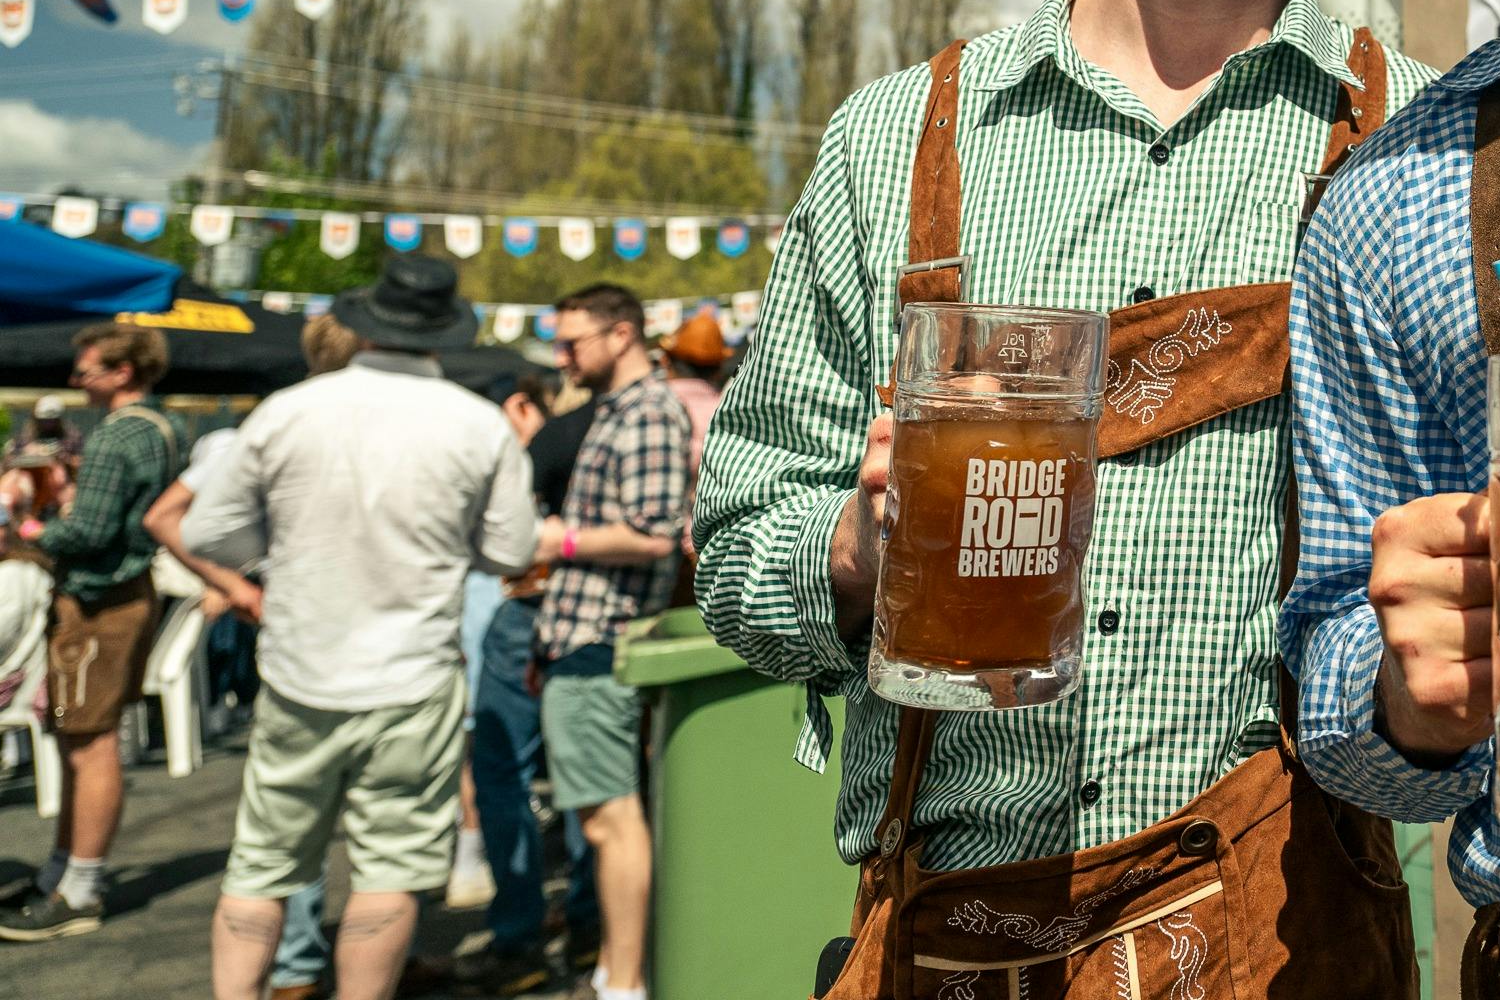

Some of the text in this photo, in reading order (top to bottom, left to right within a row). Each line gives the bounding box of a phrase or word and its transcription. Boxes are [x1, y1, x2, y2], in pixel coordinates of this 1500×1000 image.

[965, 458, 1067, 497] BRIDGE
[960, 496, 1063, 549] ROAD
[958, 546, 1059, 577] BREWERS
